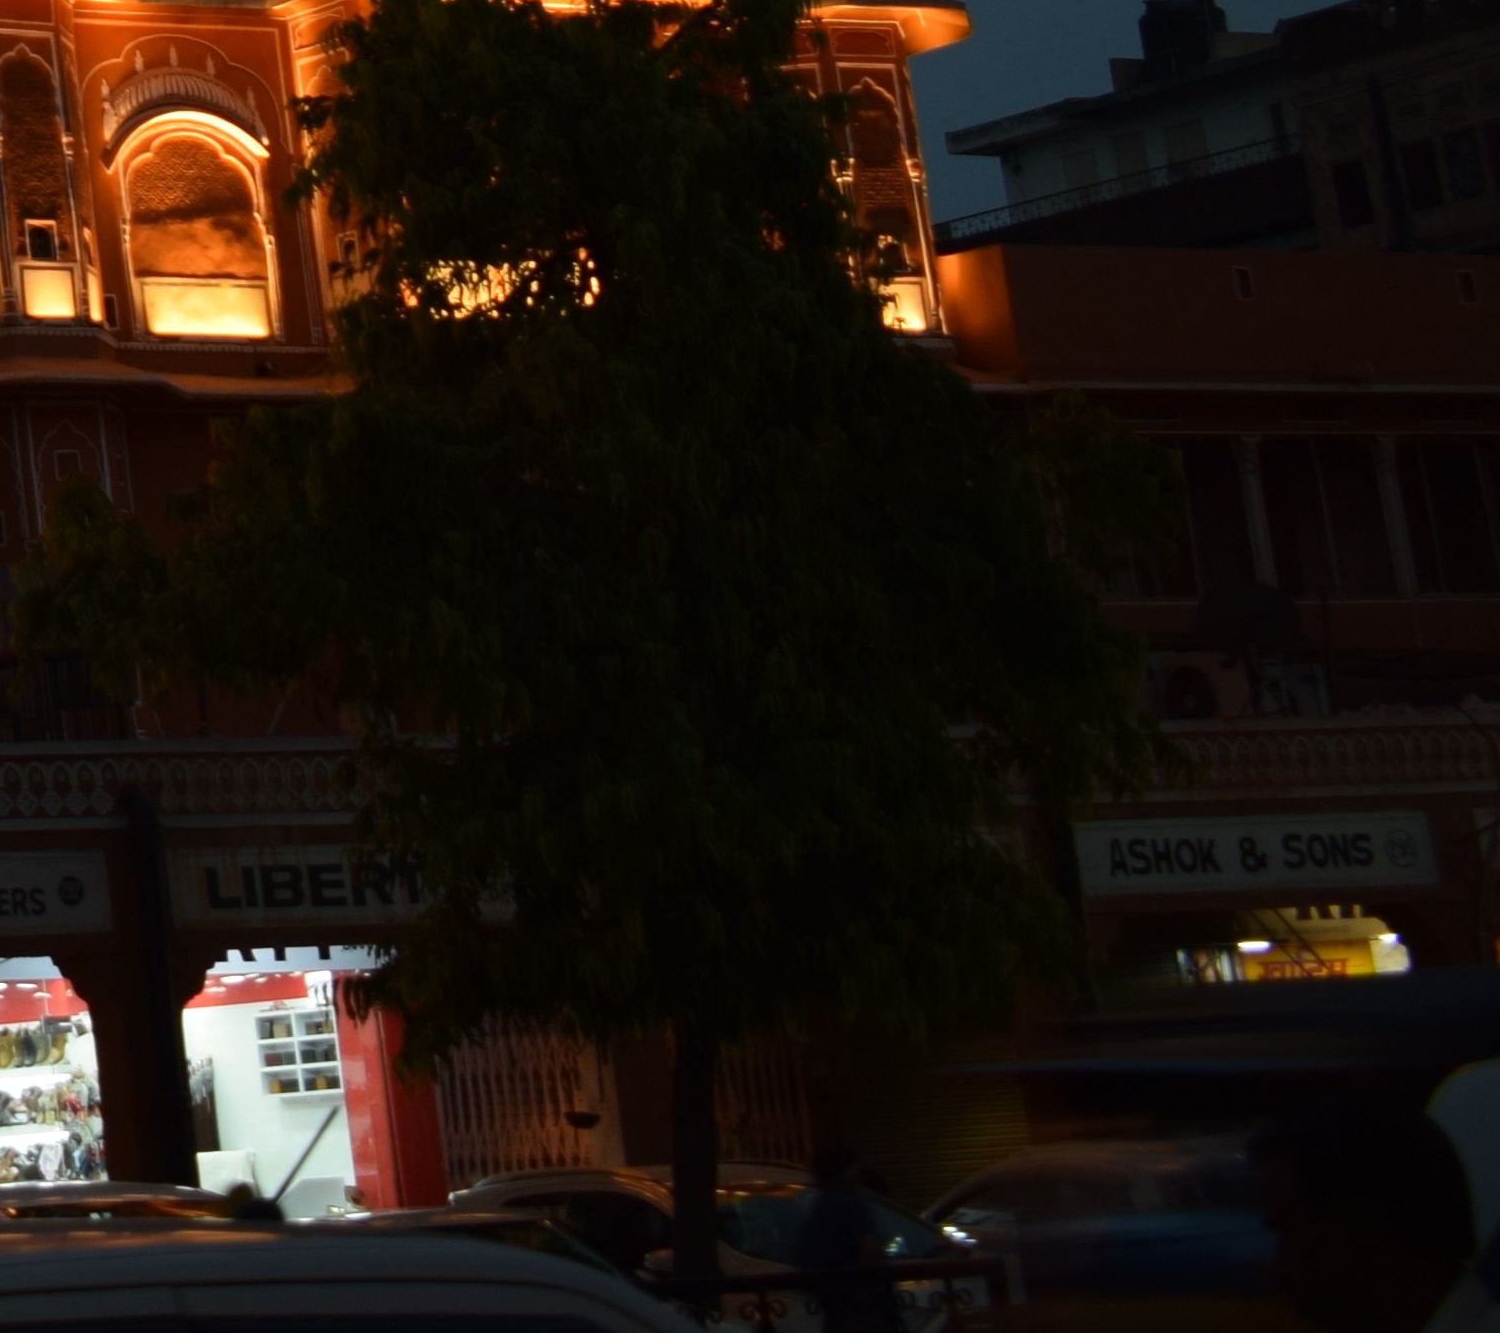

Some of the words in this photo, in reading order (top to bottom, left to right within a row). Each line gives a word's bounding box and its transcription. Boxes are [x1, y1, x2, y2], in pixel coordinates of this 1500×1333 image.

[1109, 838, 1222, 876] ASHOK
[1239, 836, 1268, 873] &
[1281, 833, 1374, 870] SONS
[203, 863, 422, 910] LIBERT
